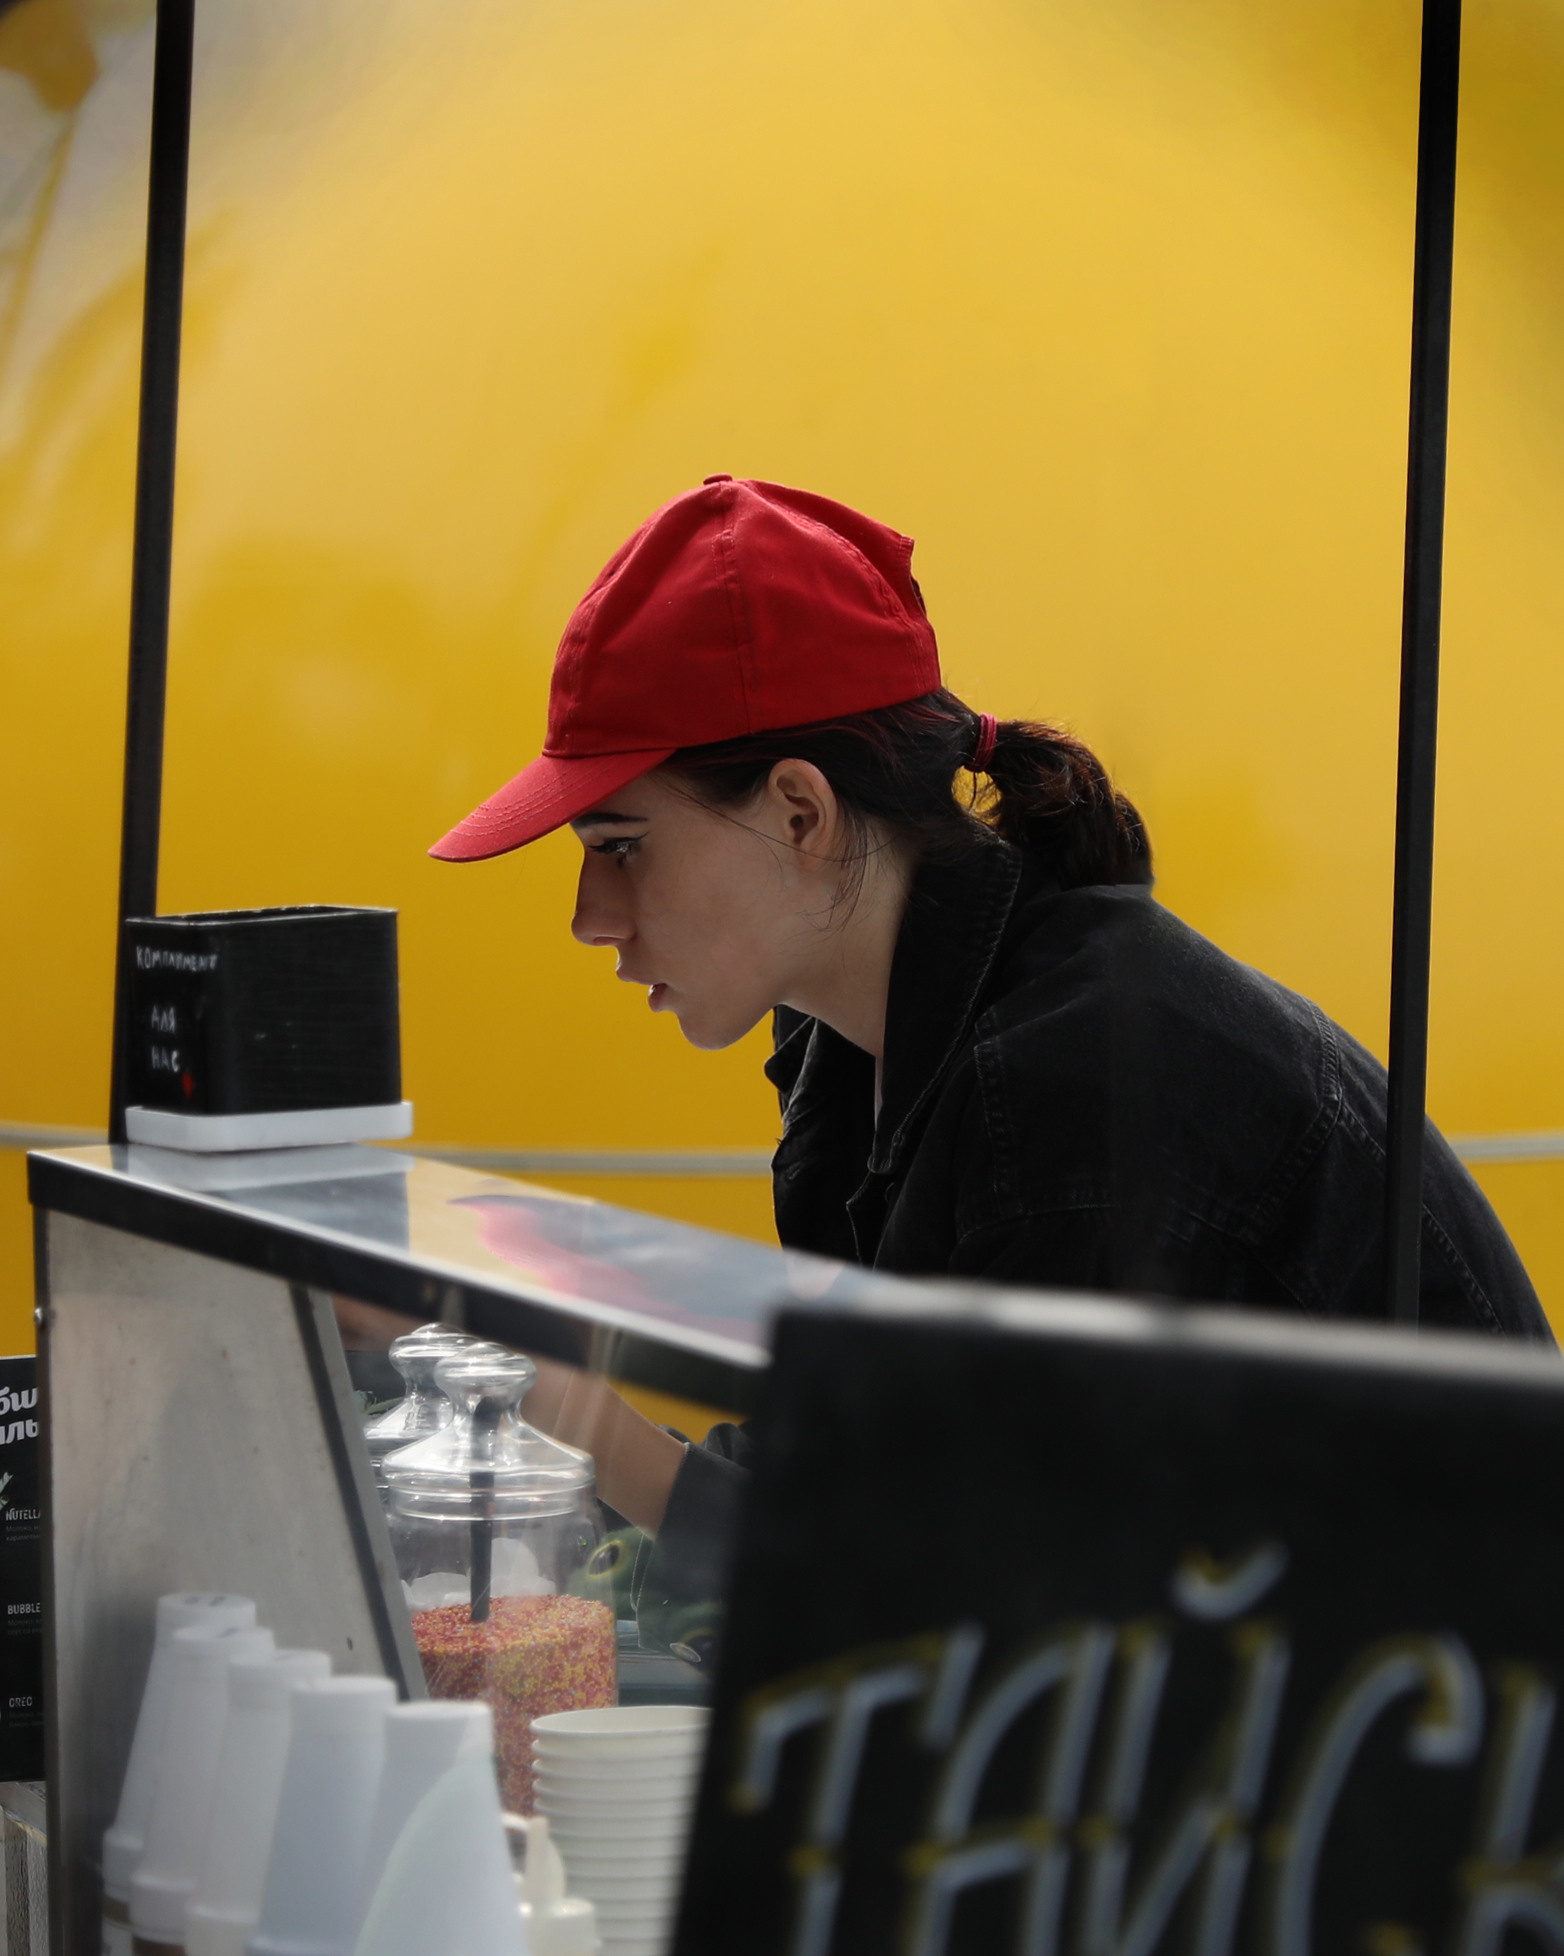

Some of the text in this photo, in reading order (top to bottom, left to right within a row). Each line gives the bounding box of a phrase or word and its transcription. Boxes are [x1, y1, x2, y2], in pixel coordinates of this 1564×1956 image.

[151, 1045, 179, 1073] НАС
[7, 1602, 41, 1615] BUBBLE
[8, 1695, 33, 1708] OREO
